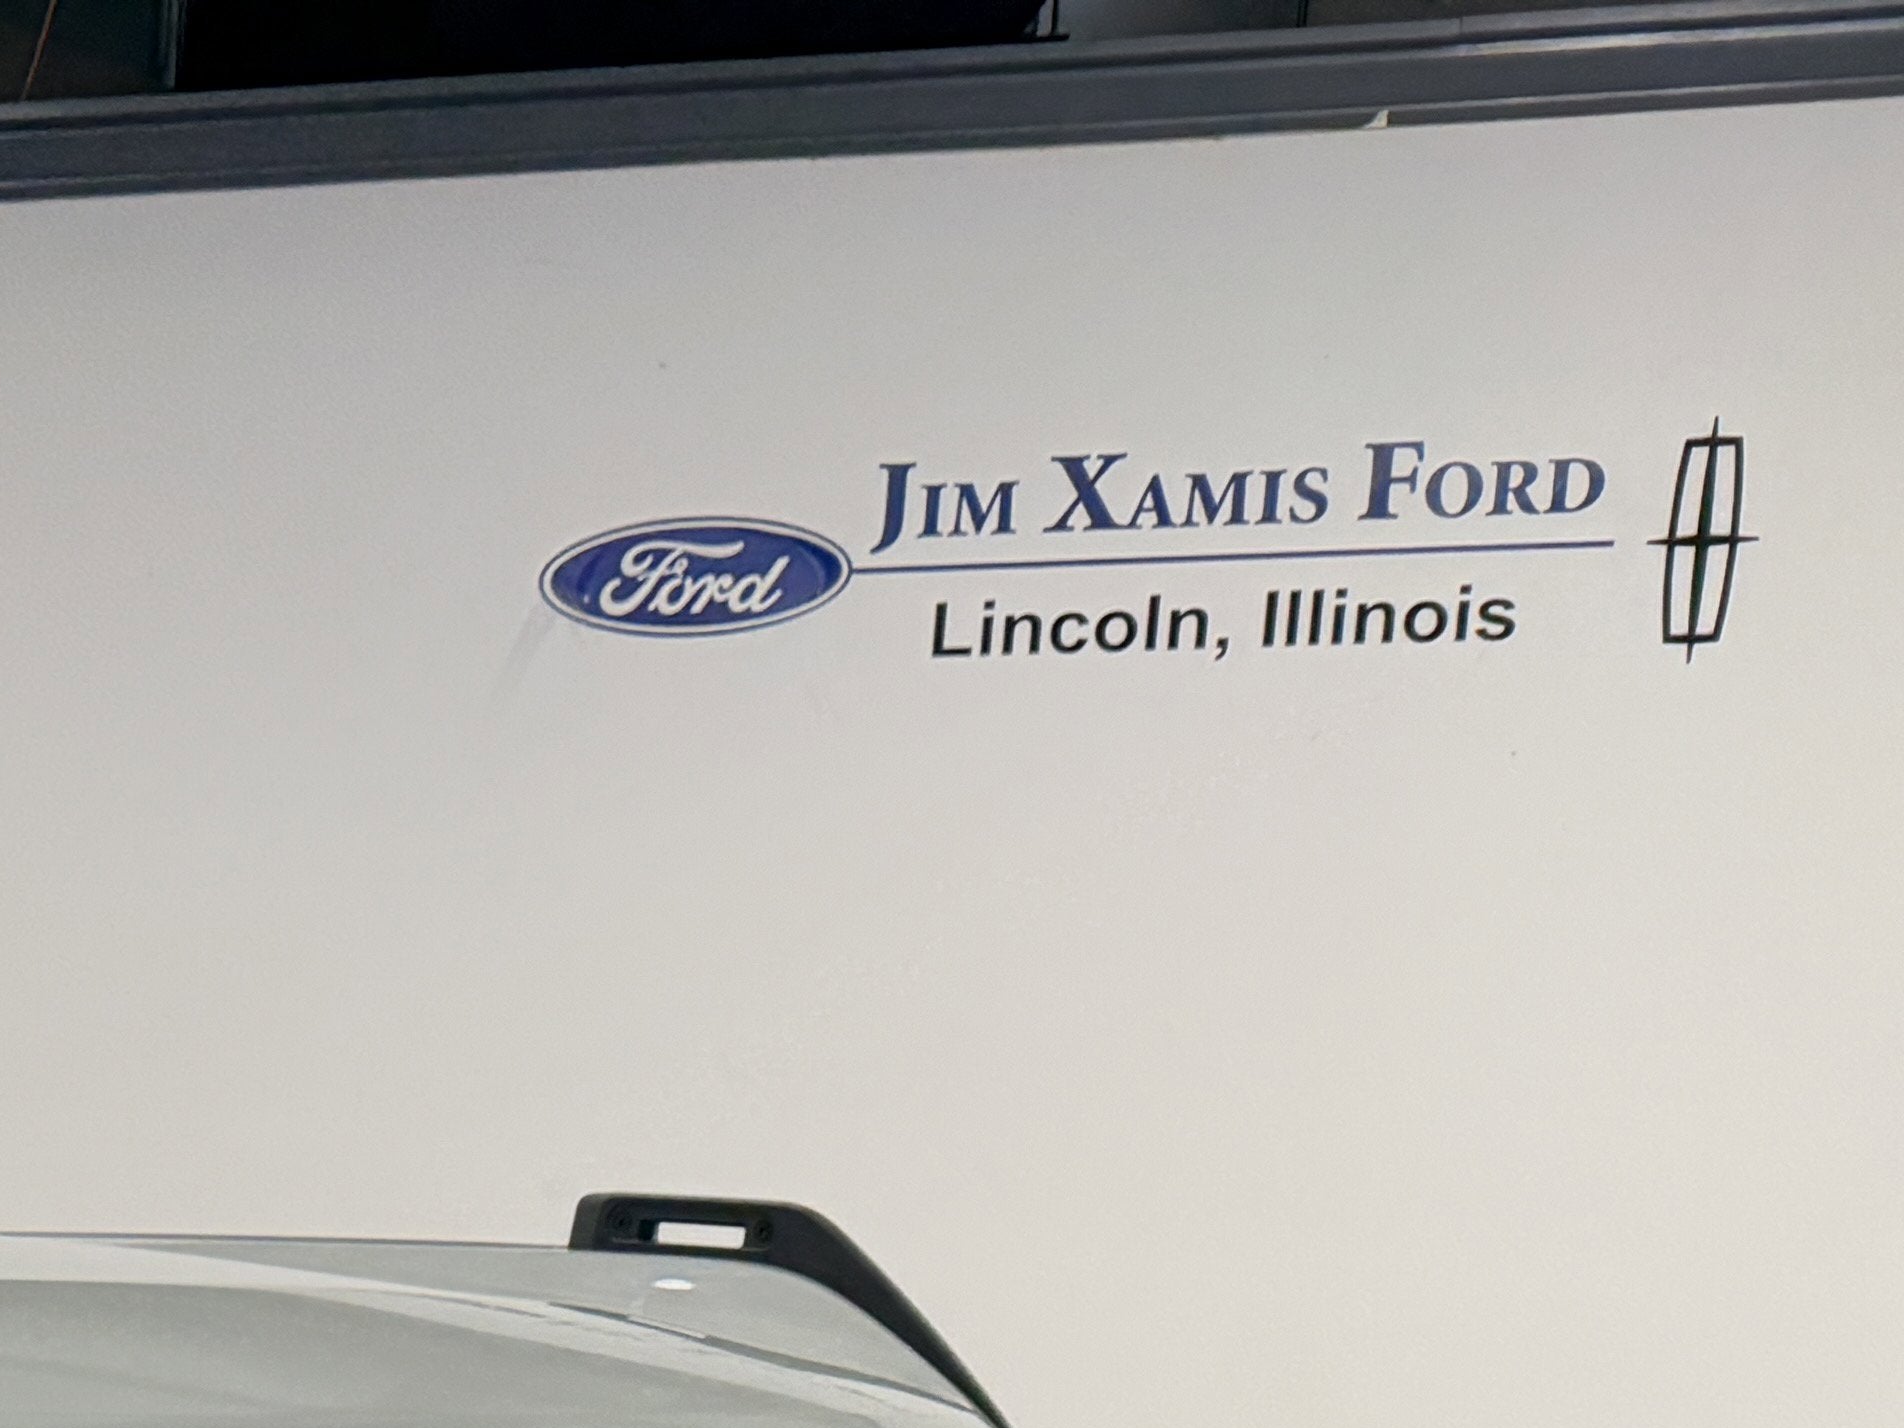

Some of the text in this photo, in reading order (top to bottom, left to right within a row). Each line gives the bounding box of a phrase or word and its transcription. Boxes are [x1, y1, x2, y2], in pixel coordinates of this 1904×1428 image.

[869, 441, 1606, 555] JIM XAMIS FORD
[598, 539, 790, 617] Ford
[931, 584, 1517, 661] Lincoln, Illinois
